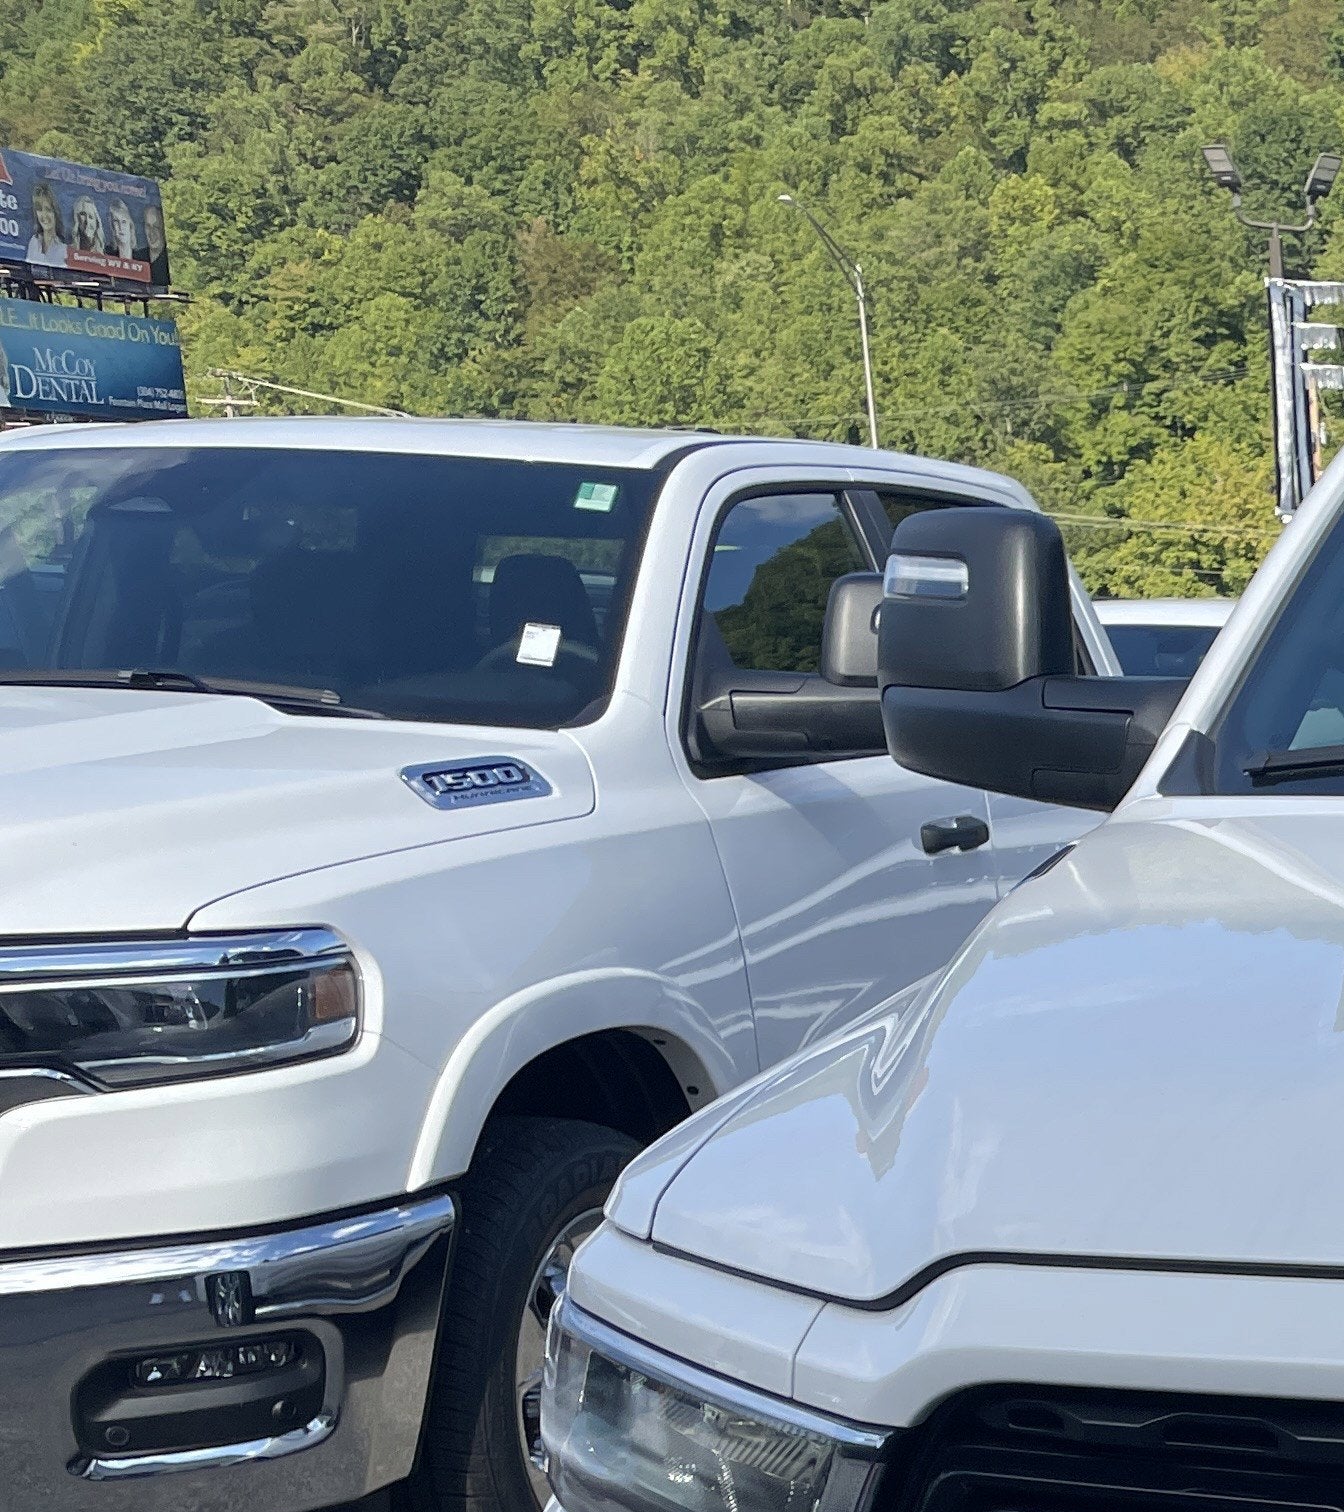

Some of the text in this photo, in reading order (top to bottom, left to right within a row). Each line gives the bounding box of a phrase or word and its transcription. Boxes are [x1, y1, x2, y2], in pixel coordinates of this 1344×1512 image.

[41, 313, 83, 335] Looks
[85, 317, 125, 340] Good
[128, 322, 150, 343] On
[11, 363, 104, 404] DENTAL
[426, 765, 524, 795] 1500
